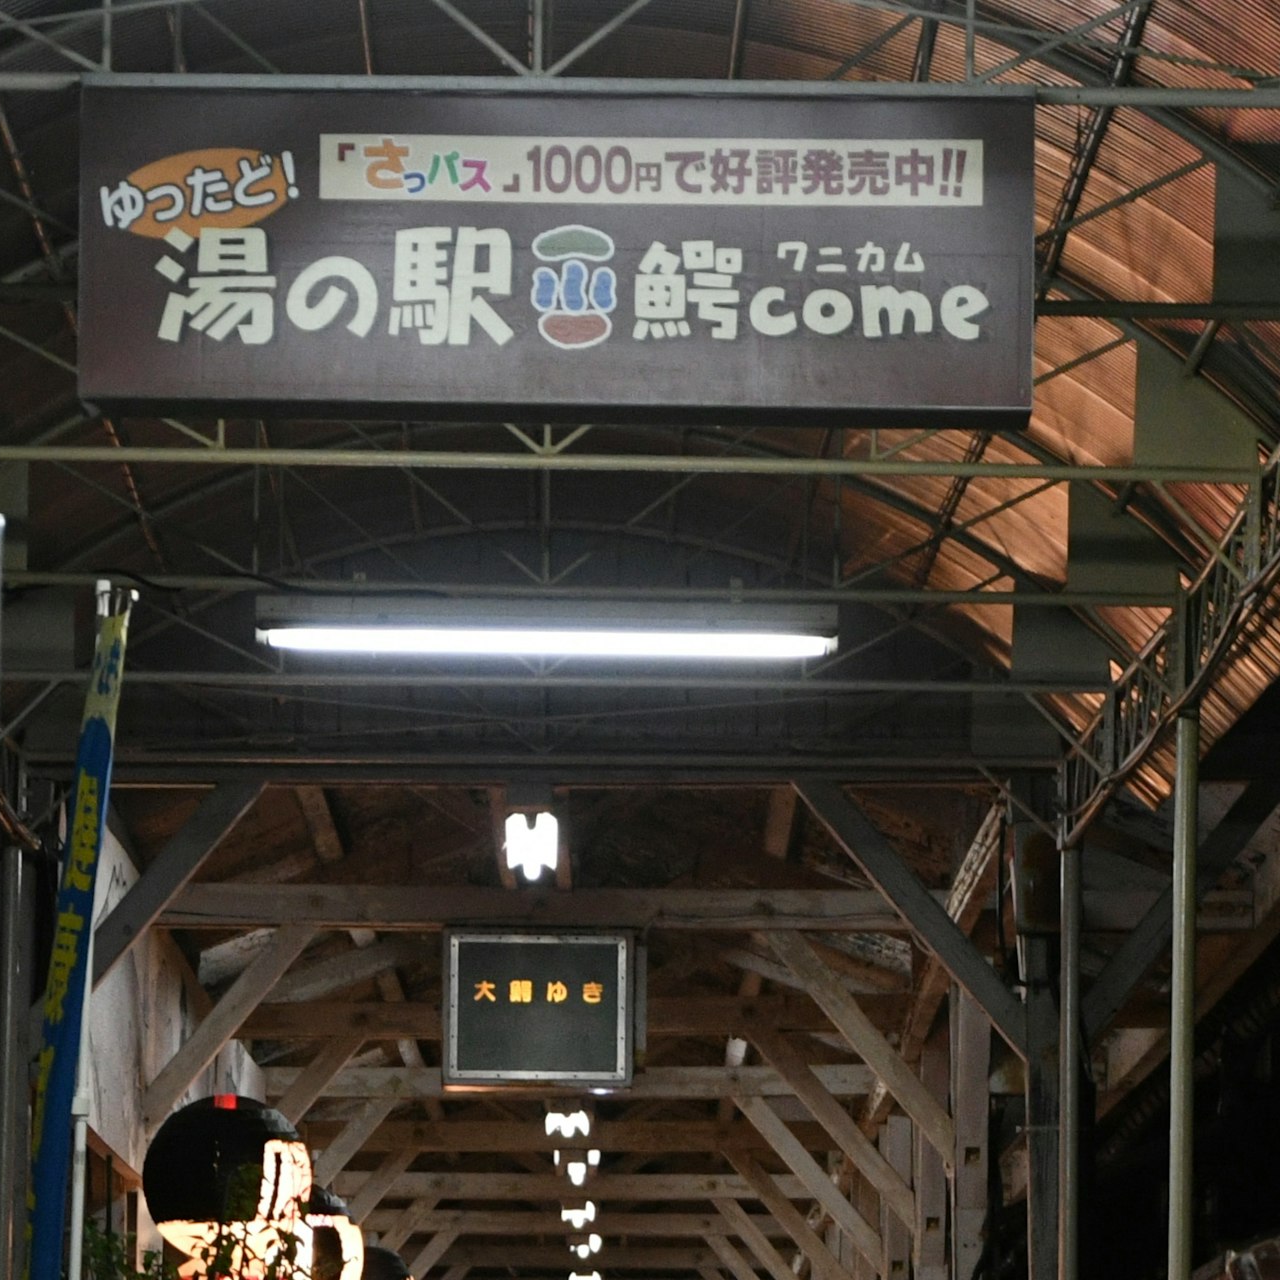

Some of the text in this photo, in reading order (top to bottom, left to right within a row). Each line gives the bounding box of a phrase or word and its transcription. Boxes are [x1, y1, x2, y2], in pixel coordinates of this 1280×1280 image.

[99, 150, 300, 230] ゆったど!
[154, 226, 515, 346] 湯の駅
[776, 240, 926, 273] ワニカム
